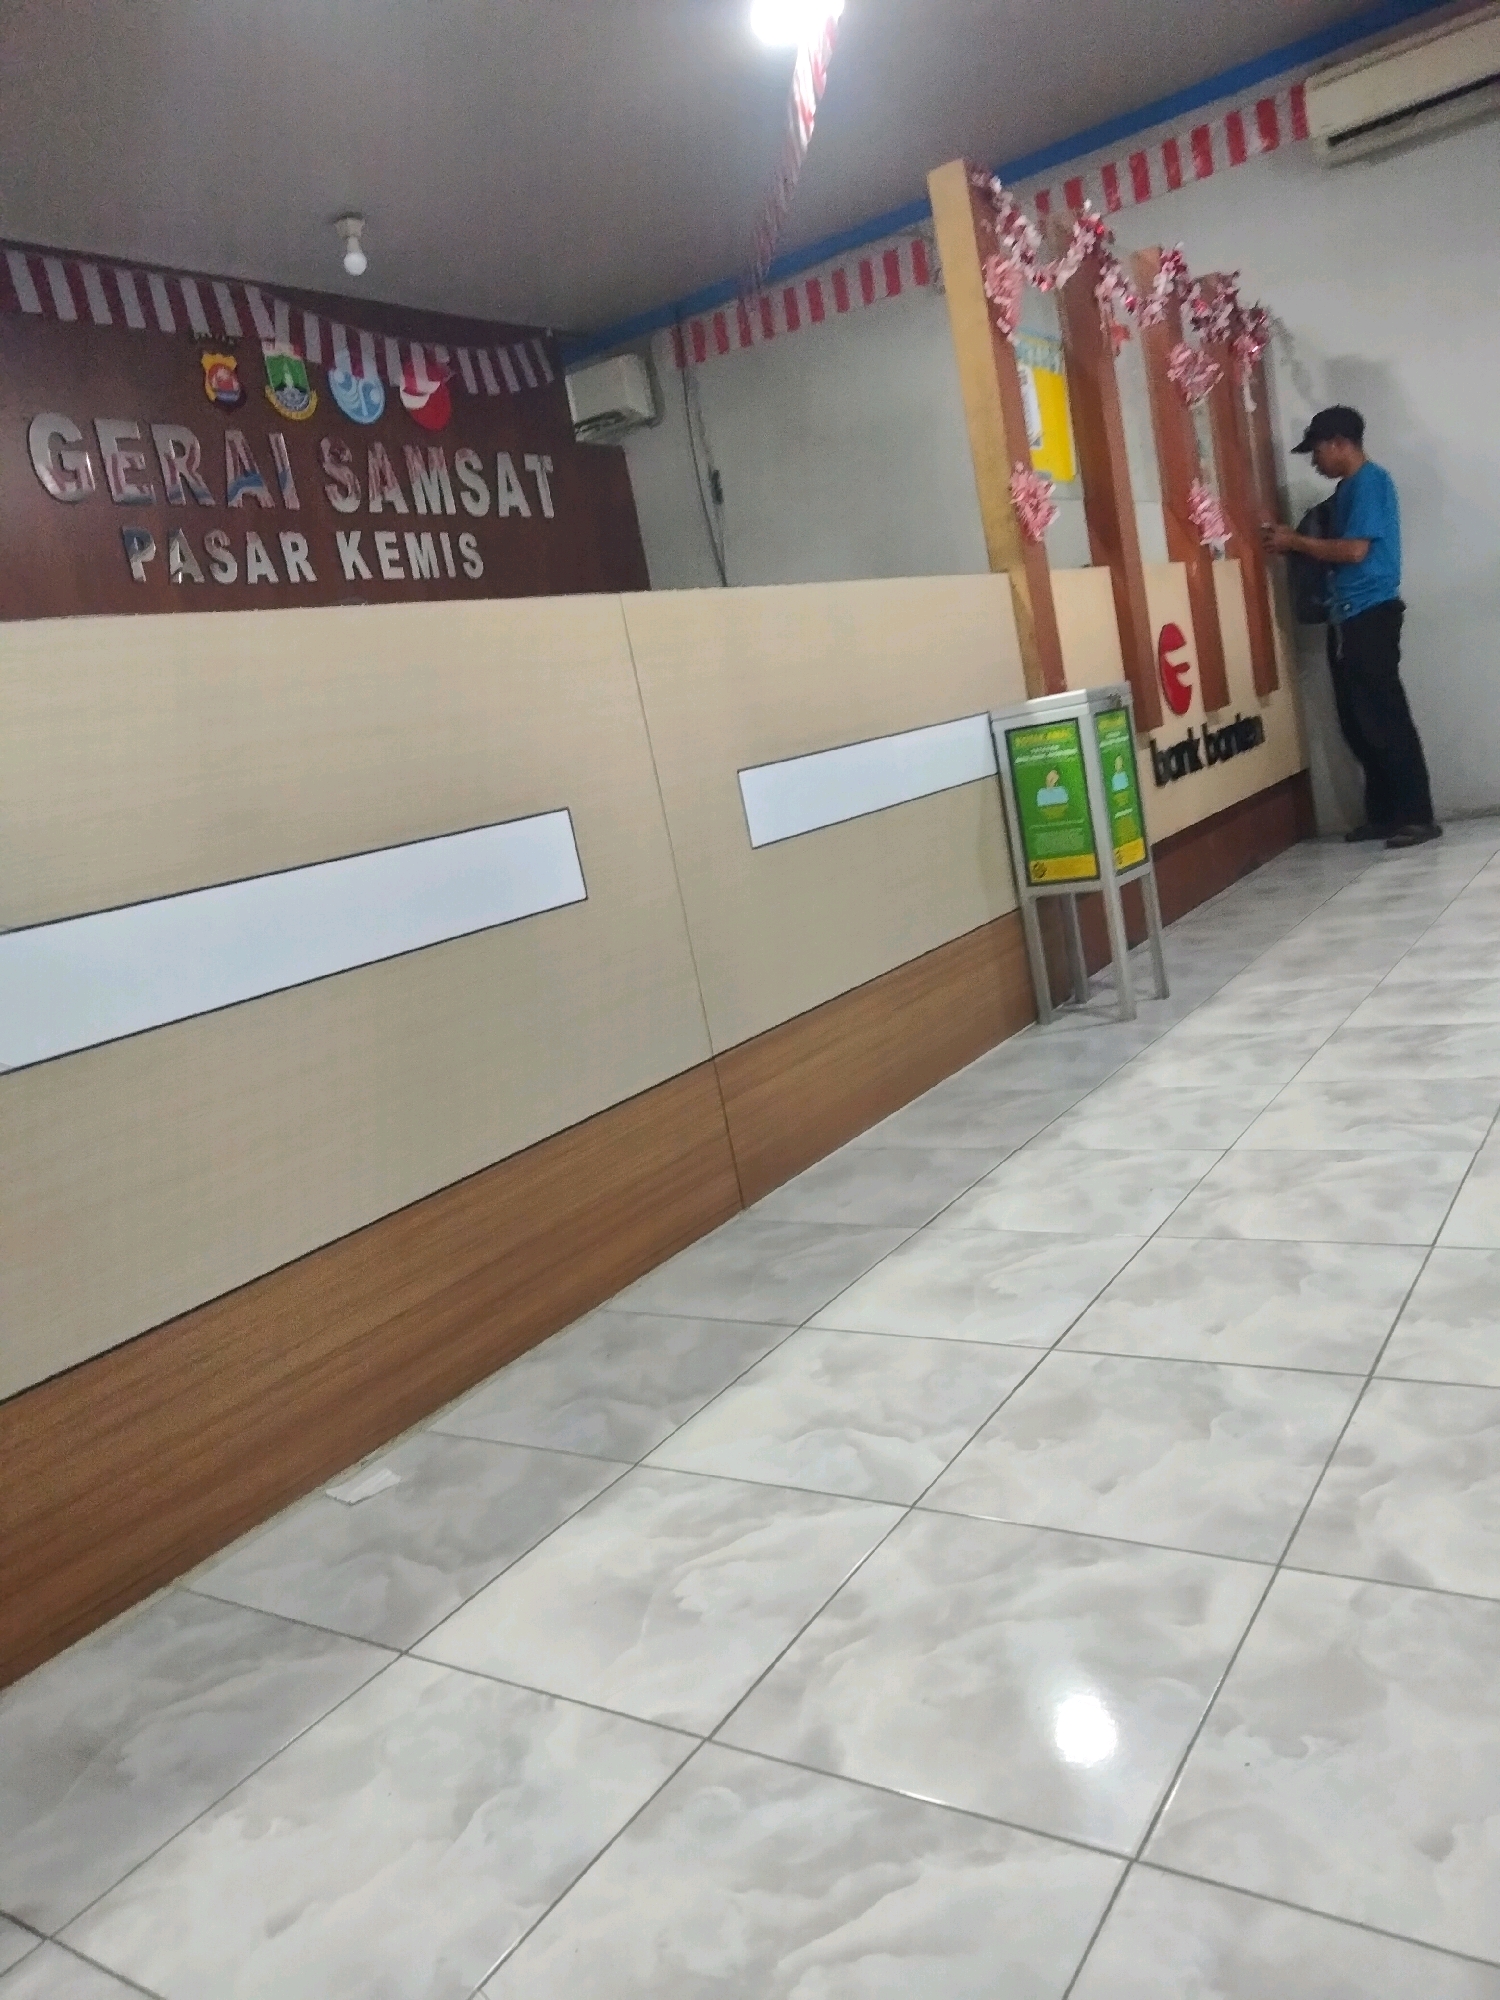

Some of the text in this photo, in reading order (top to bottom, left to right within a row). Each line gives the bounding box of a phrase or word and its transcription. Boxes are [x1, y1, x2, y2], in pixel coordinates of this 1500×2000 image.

[28, 412, 555, 518] GERAI SAMSAT
[123, 527, 484, 584] PASAR KEMIS
[1150, 727, 1204, 787] bank
